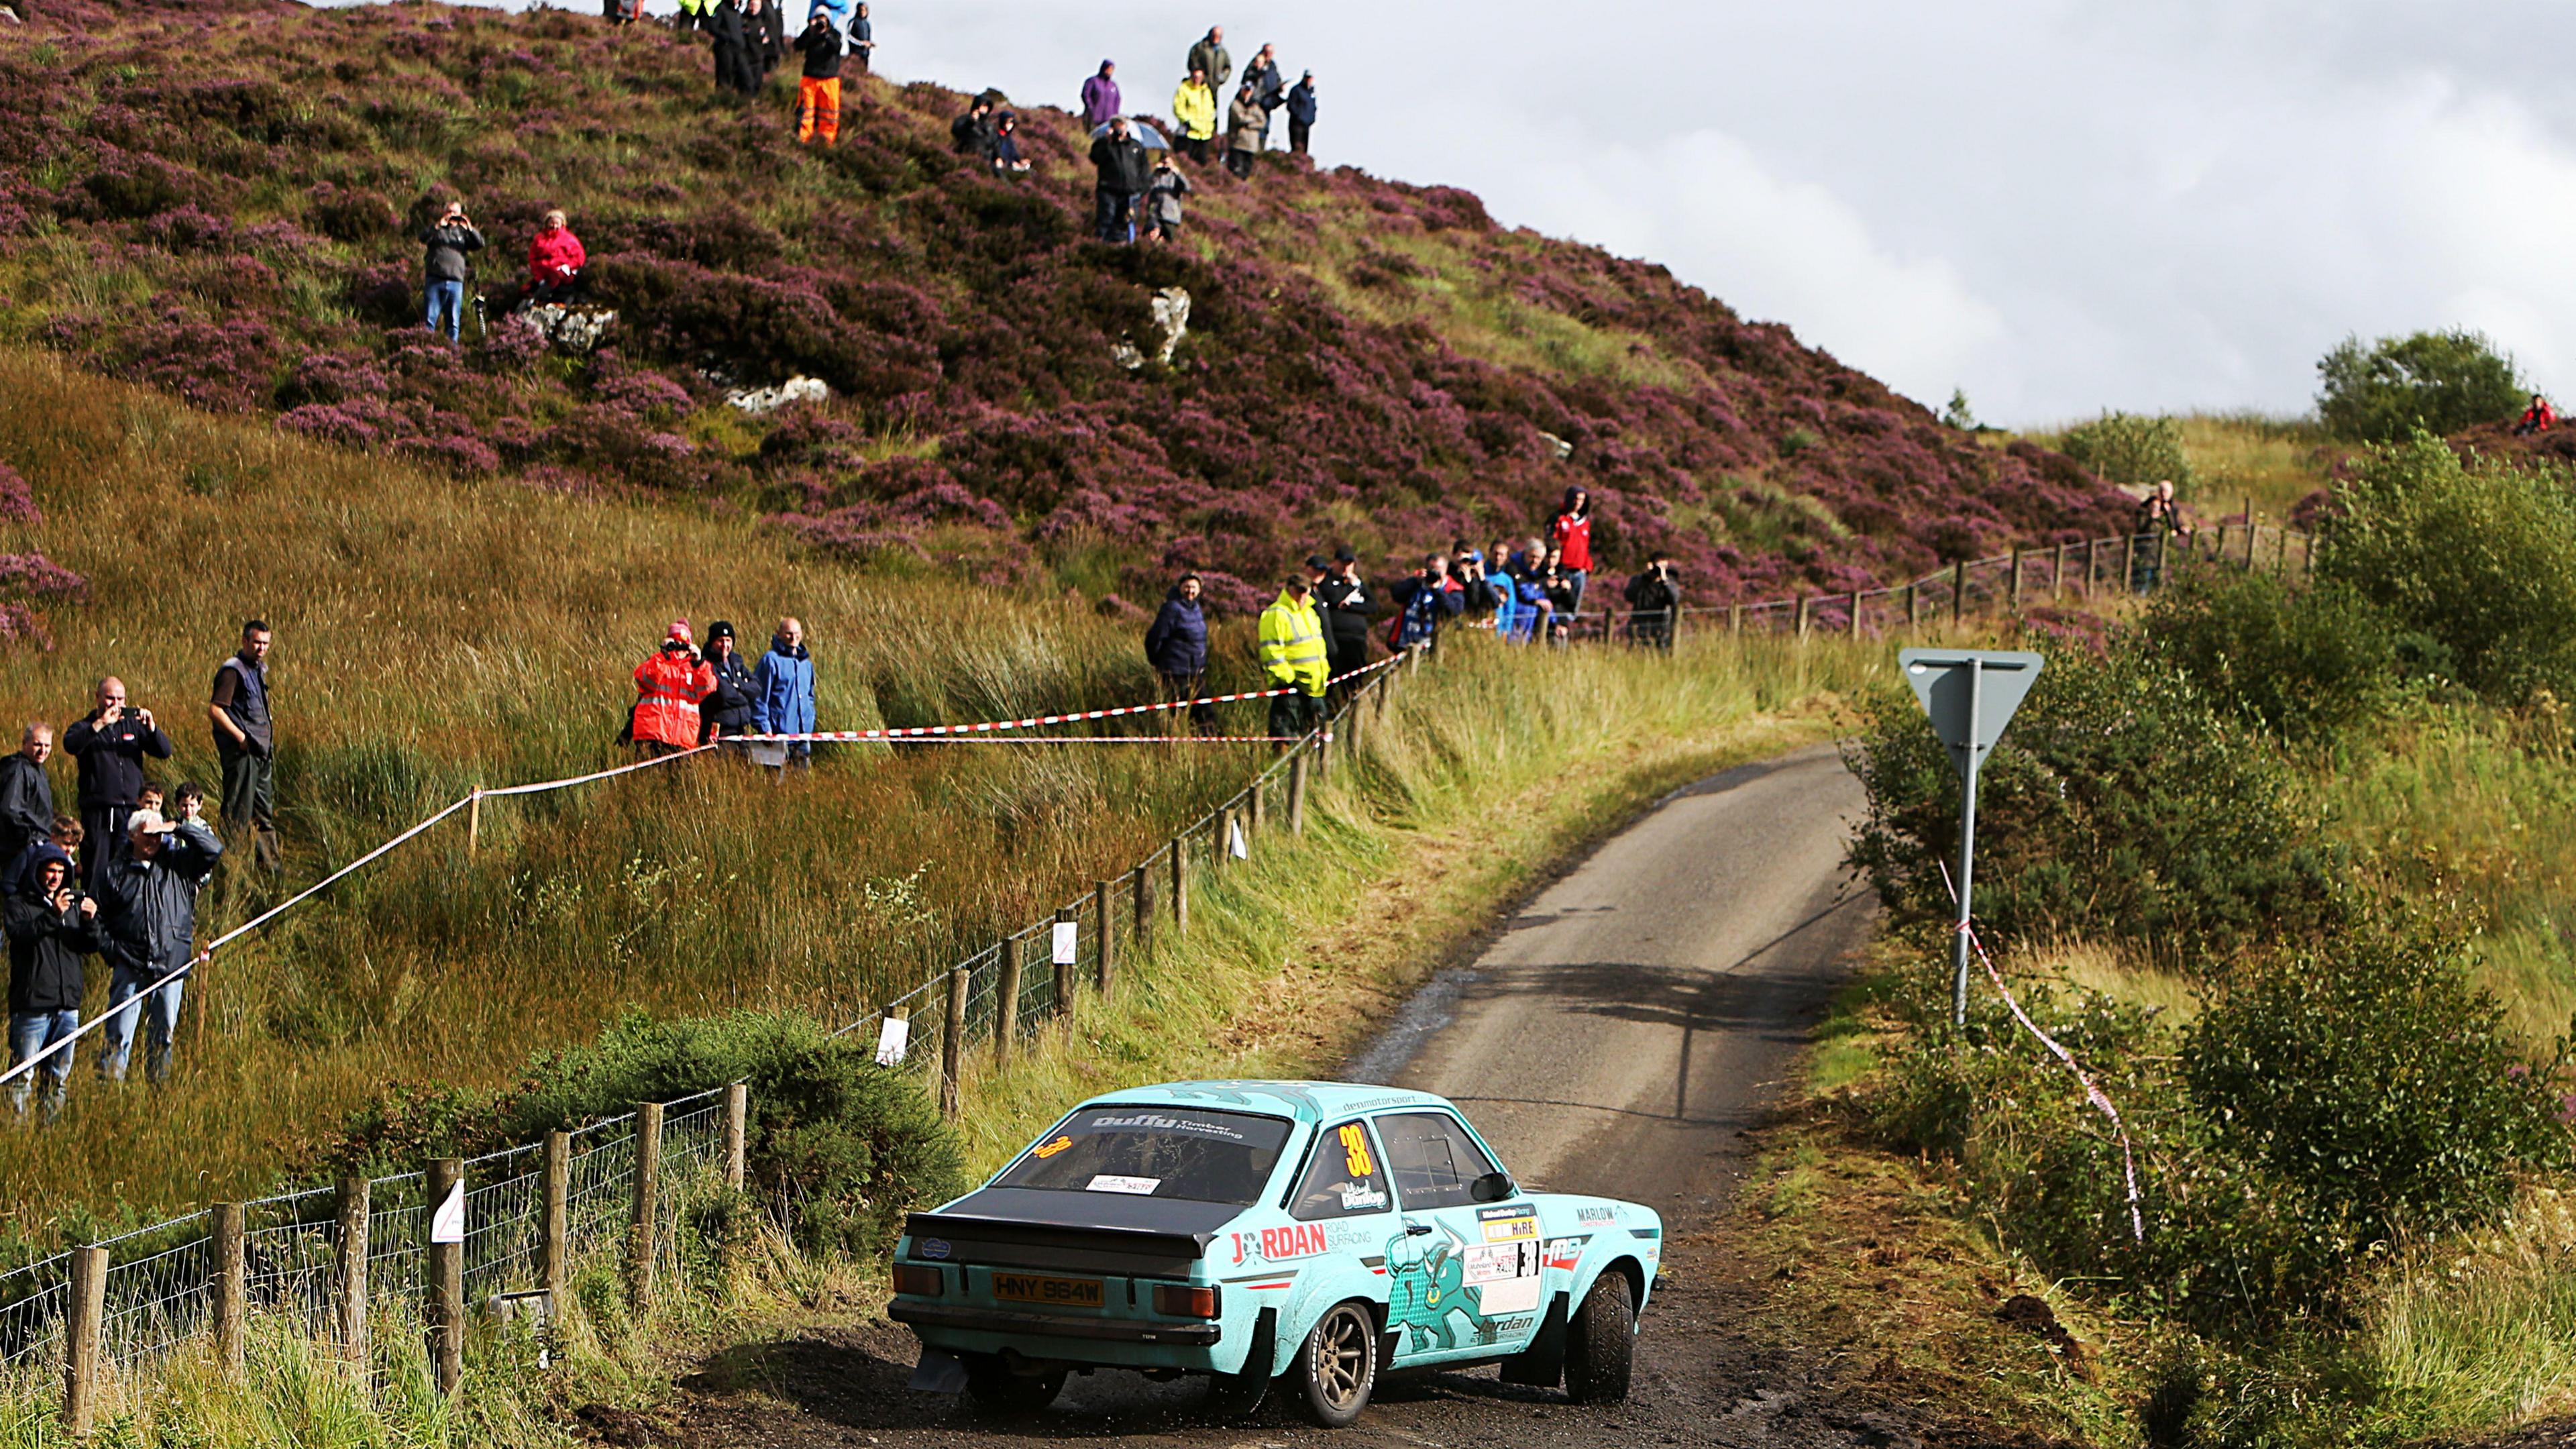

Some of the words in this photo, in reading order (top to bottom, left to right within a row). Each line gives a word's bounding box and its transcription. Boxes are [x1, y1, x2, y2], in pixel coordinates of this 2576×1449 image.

[1091, 1115, 1177, 1128] Duffy
[1181, 1120, 1231, 1131] Timber
[1175, 1124, 1243, 1139] Harvesting
[1339, 1124, 1373, 1177] 38
[1341, 1191, 1387, 1210] Dunlop
[1576, 1207, 1614, 1222] MARLOW
[1325, 1221, 1349, 1233] ROAD
[1328, 1231, 1372, 1246] SURFACING
[1520, 1240, 1537, 1277] 38
[996, 1277, 1037, 1296] HNY
[1043, 1281, 1098, 1301] 964W
